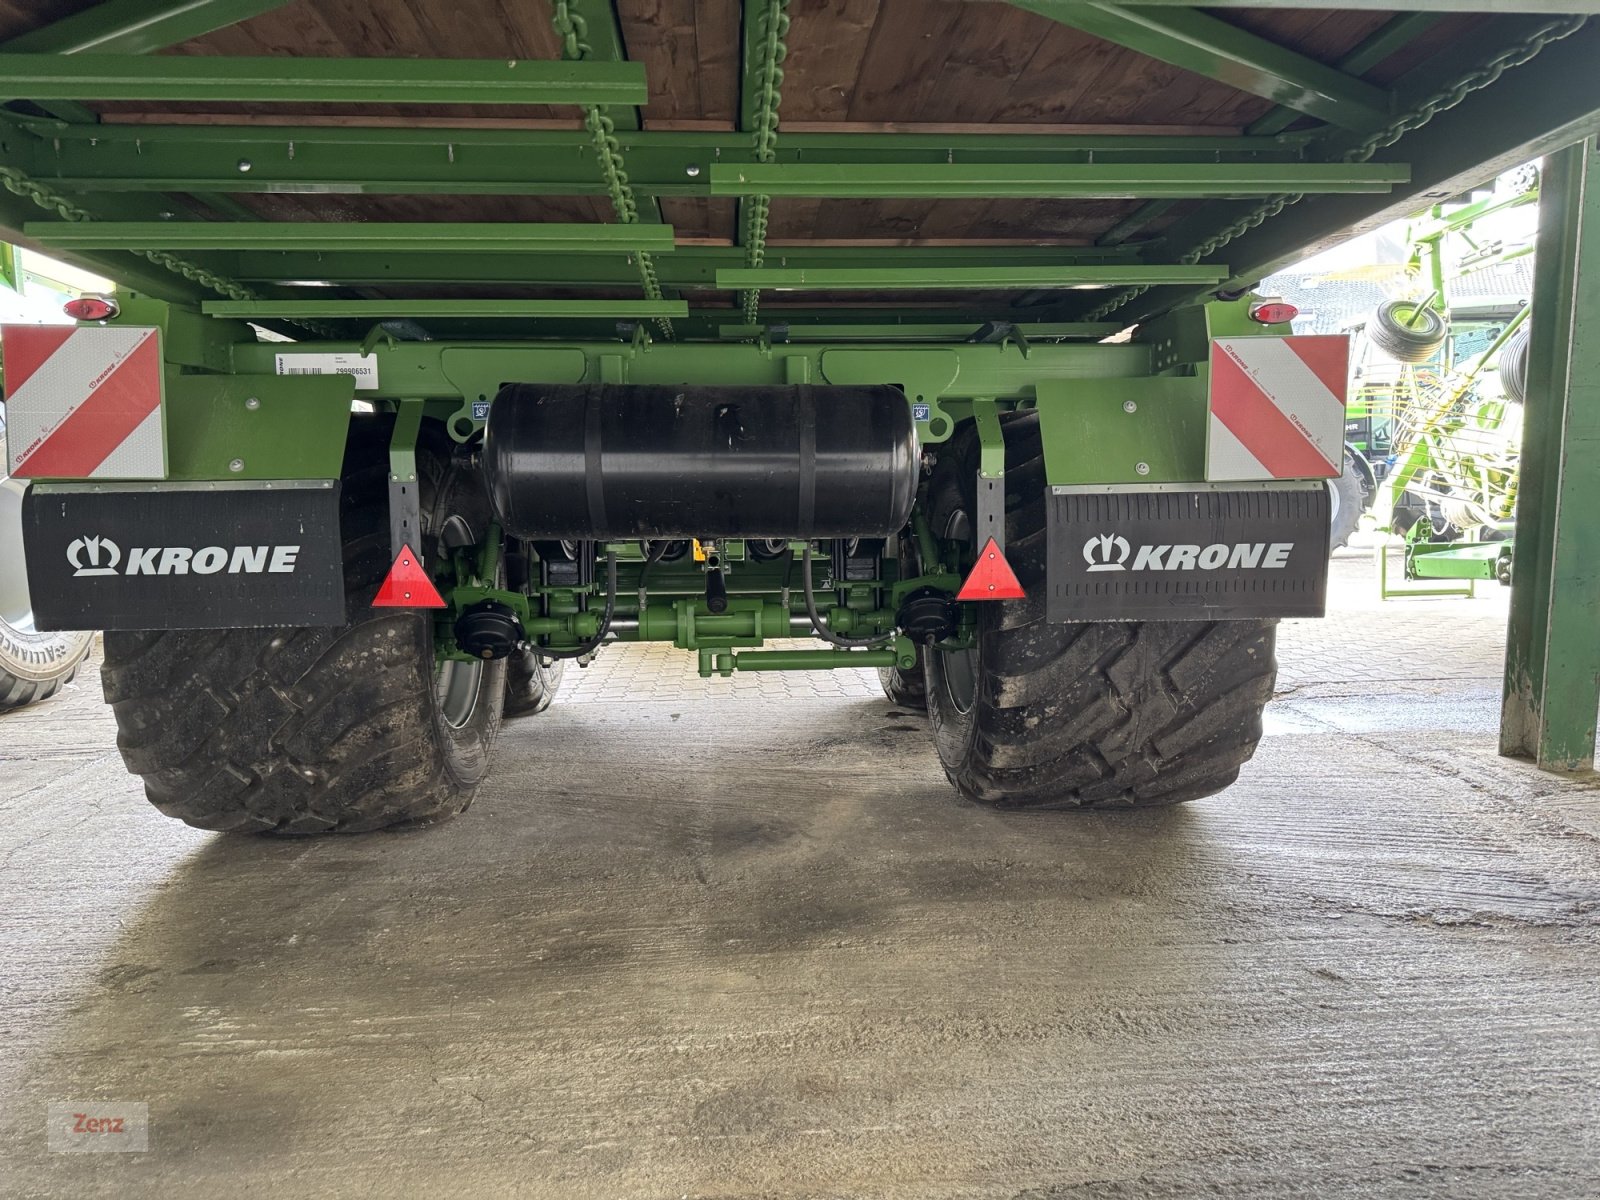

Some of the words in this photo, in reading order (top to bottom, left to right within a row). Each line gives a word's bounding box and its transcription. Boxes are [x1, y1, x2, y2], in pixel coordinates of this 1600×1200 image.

[95, 363, 116, 384] KRONE
[1345, 423, 1358, 431] HR
[22, 437, 42, 458] KRONE
[125, 545, 300, 575] KRONE
[1131, 543, 1295, 570] KRONE
